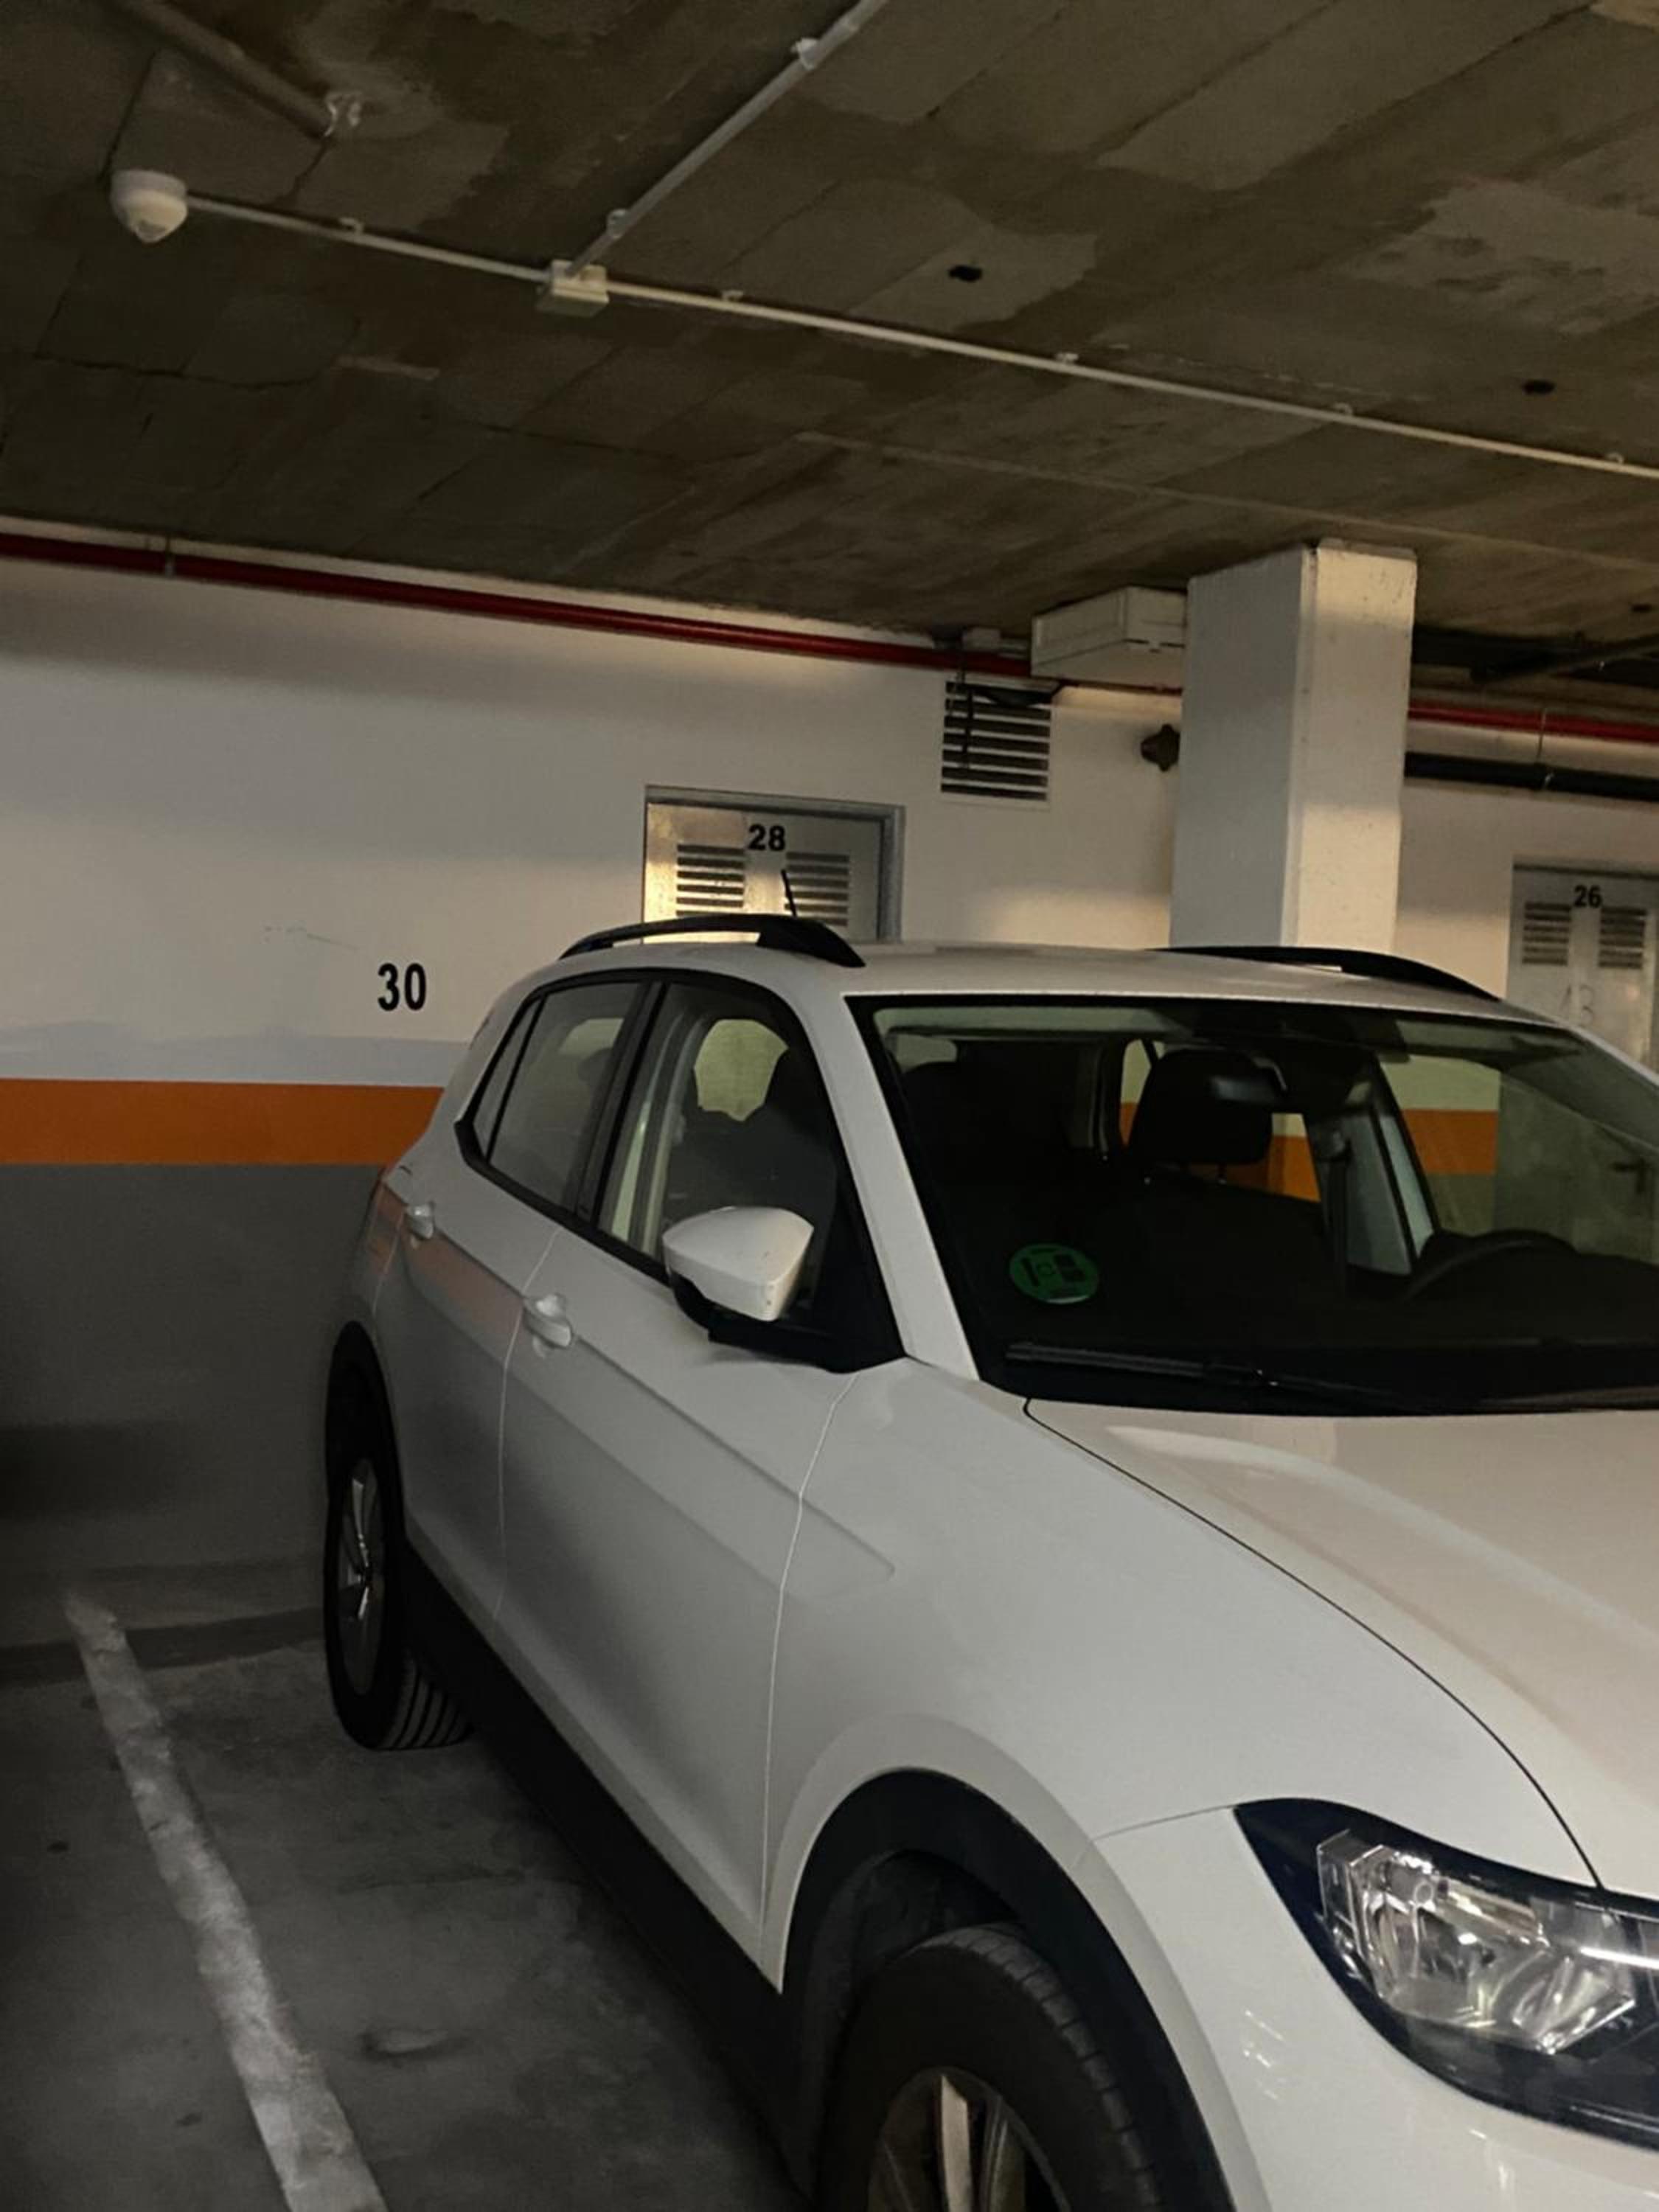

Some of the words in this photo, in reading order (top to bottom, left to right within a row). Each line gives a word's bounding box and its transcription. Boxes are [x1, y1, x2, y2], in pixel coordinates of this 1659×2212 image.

[748, 824, 786, 852] 28
[1574, 885, 1602, 908] 26
[378, 963, 426, 1011] 30
